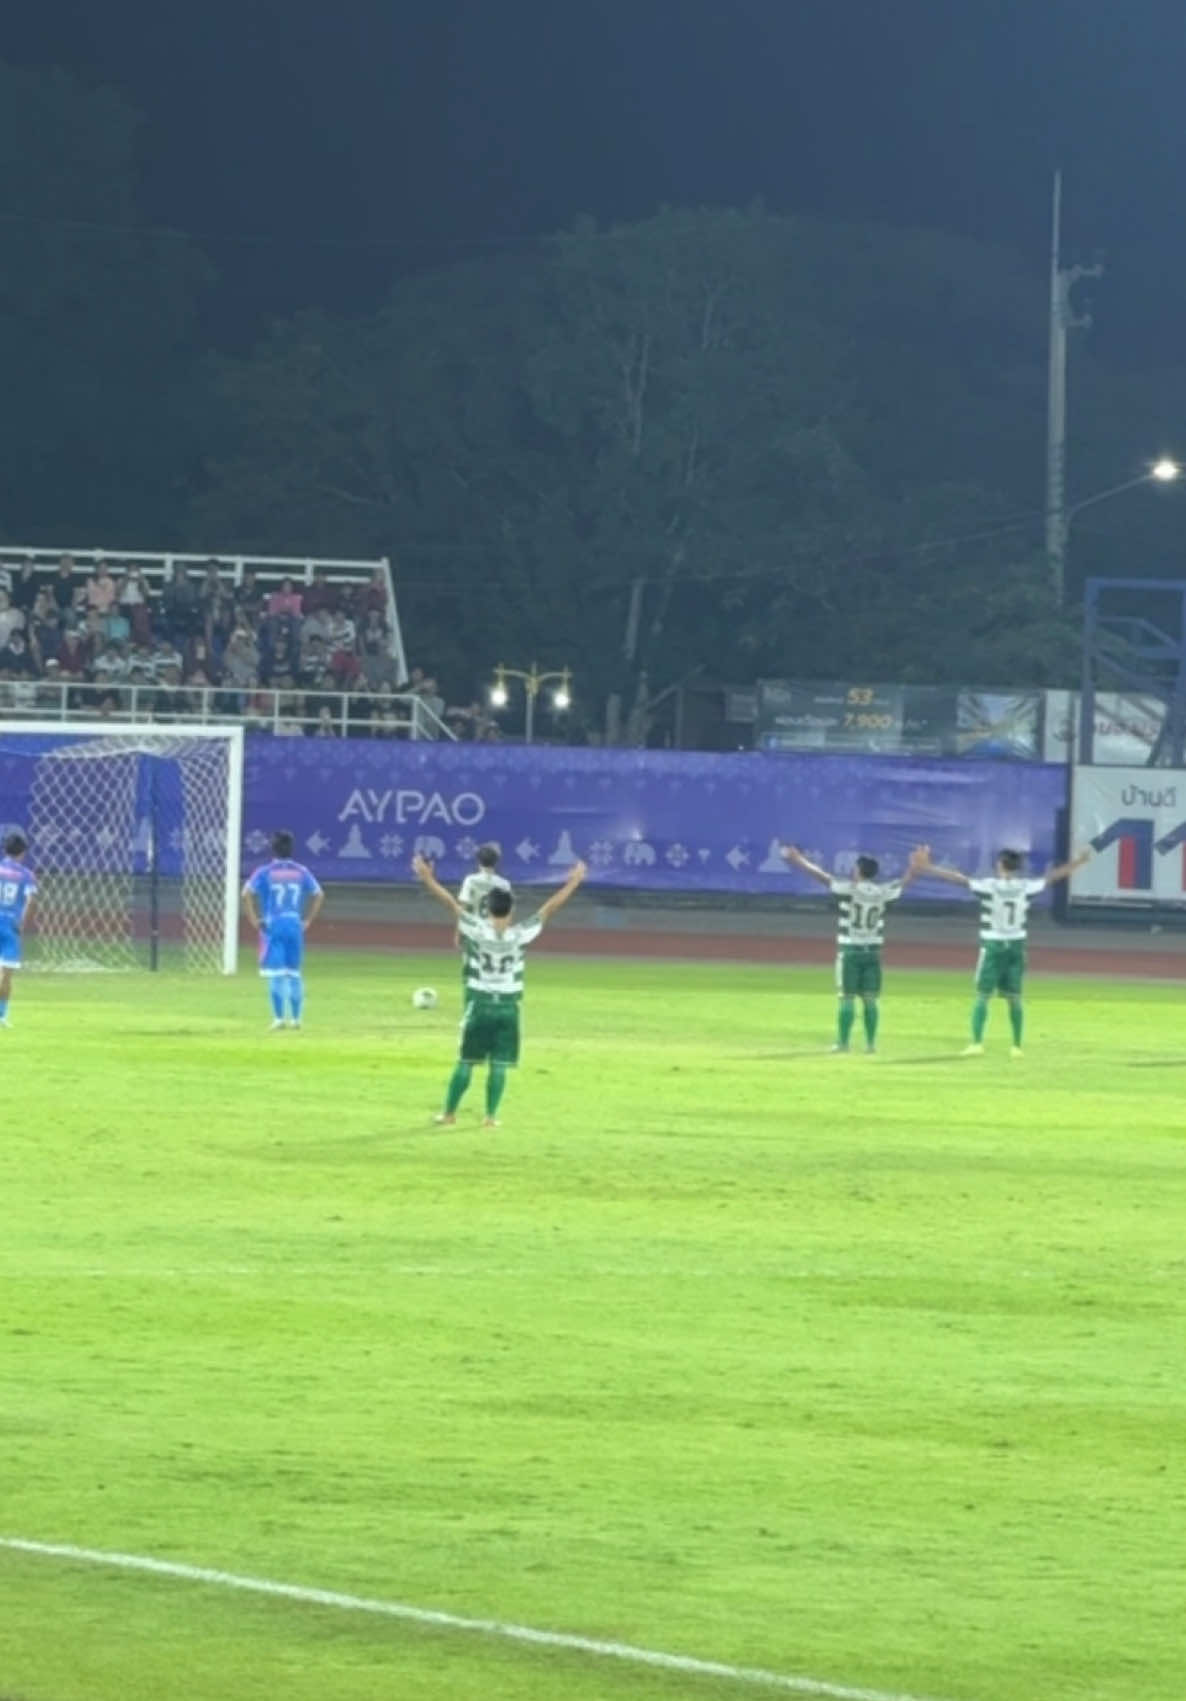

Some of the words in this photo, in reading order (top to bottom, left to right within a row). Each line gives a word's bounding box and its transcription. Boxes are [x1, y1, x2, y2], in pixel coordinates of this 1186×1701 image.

[337, 788, 486, 826] AYPAO
[270, 882, 301, 908] 77
[1003, 901, 1017, 926] 7
